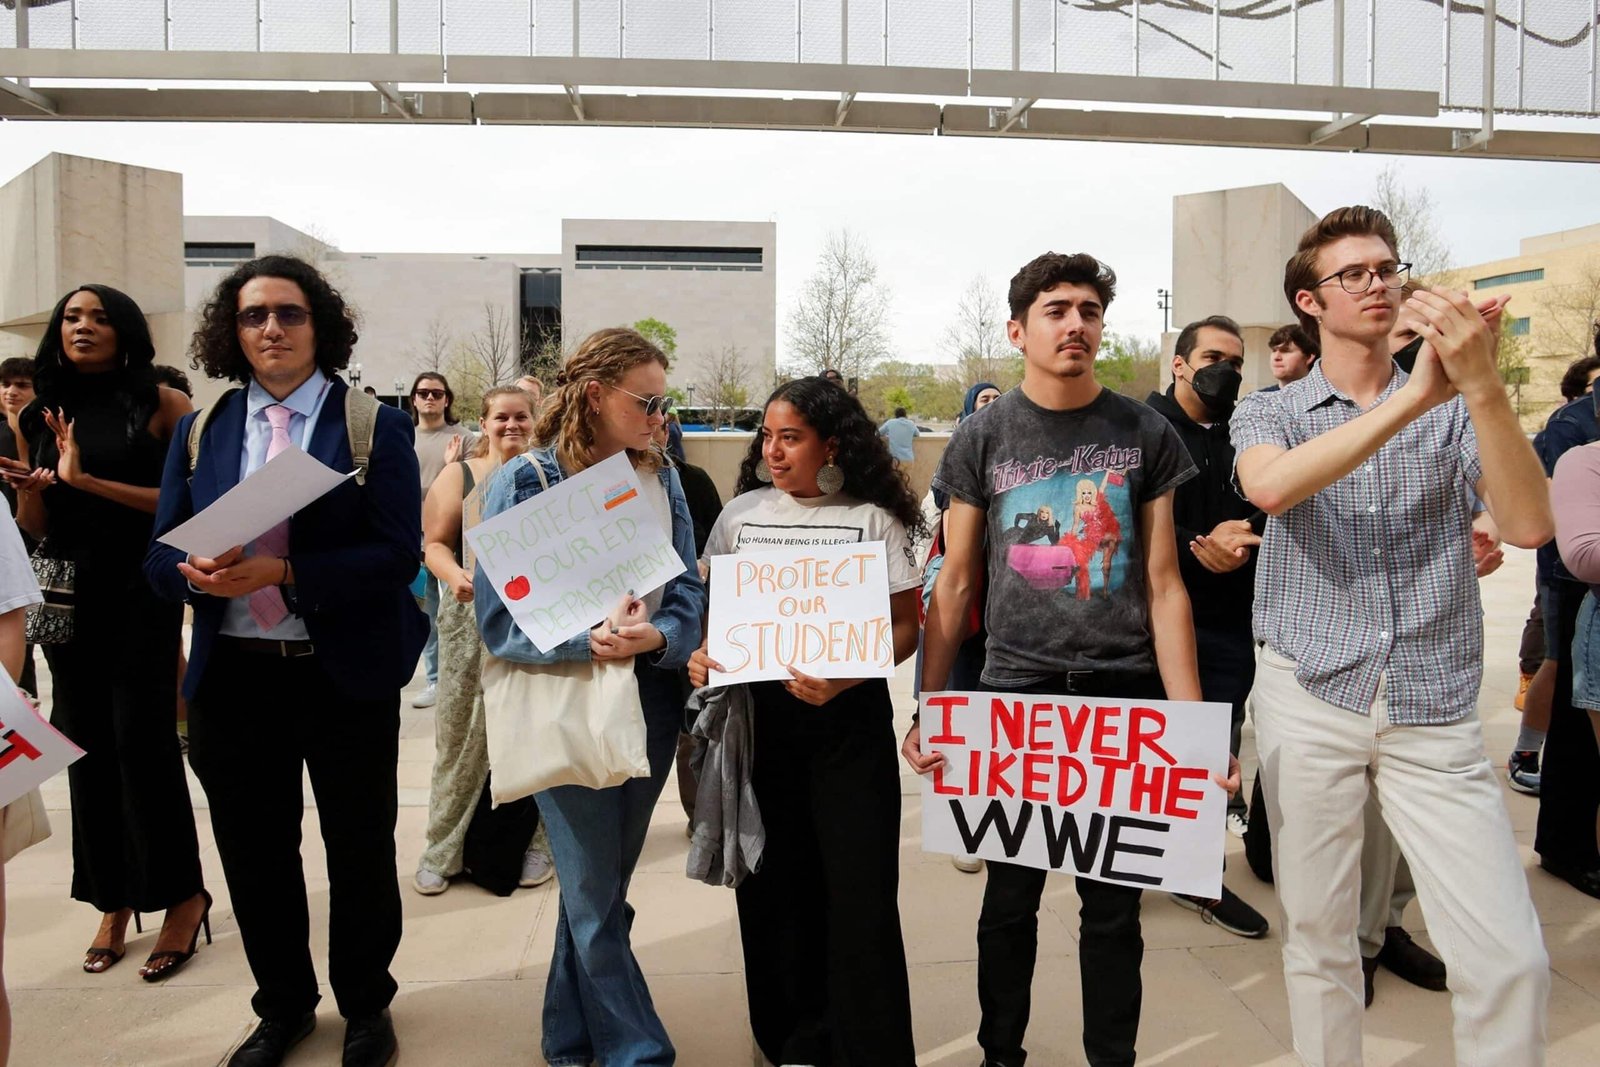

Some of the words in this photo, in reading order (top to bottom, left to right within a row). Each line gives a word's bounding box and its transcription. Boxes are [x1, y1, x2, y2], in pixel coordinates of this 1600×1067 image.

[993, 456, 1057, 495] Trixie
[1071, 443, 1142, 476] Katya
[477, 483, 599, 569] PROTECT
[533, 537, 599, 584] OUR
[600, 517, 638, 551] ED
[741, 536, 751, 544] NO
[752, 536, 783, 545] HUMAN
[821, 538, 854, 546] ILLEGA
[529, 540, 676, 636] DEPARTMENT
[736, 554, 877, 597] PROTECT
[778, 595, 827, 617] OUR
[725, 617, 893, 673] STUDENTS
[926, 696, 969, 745] I
[990, 698, 1178, 766] NEVER
[931, 750, 1088, 807] LIKED
[1092, 755, 1209, 820] THE
[948, 798, 1170, 886] WWE
